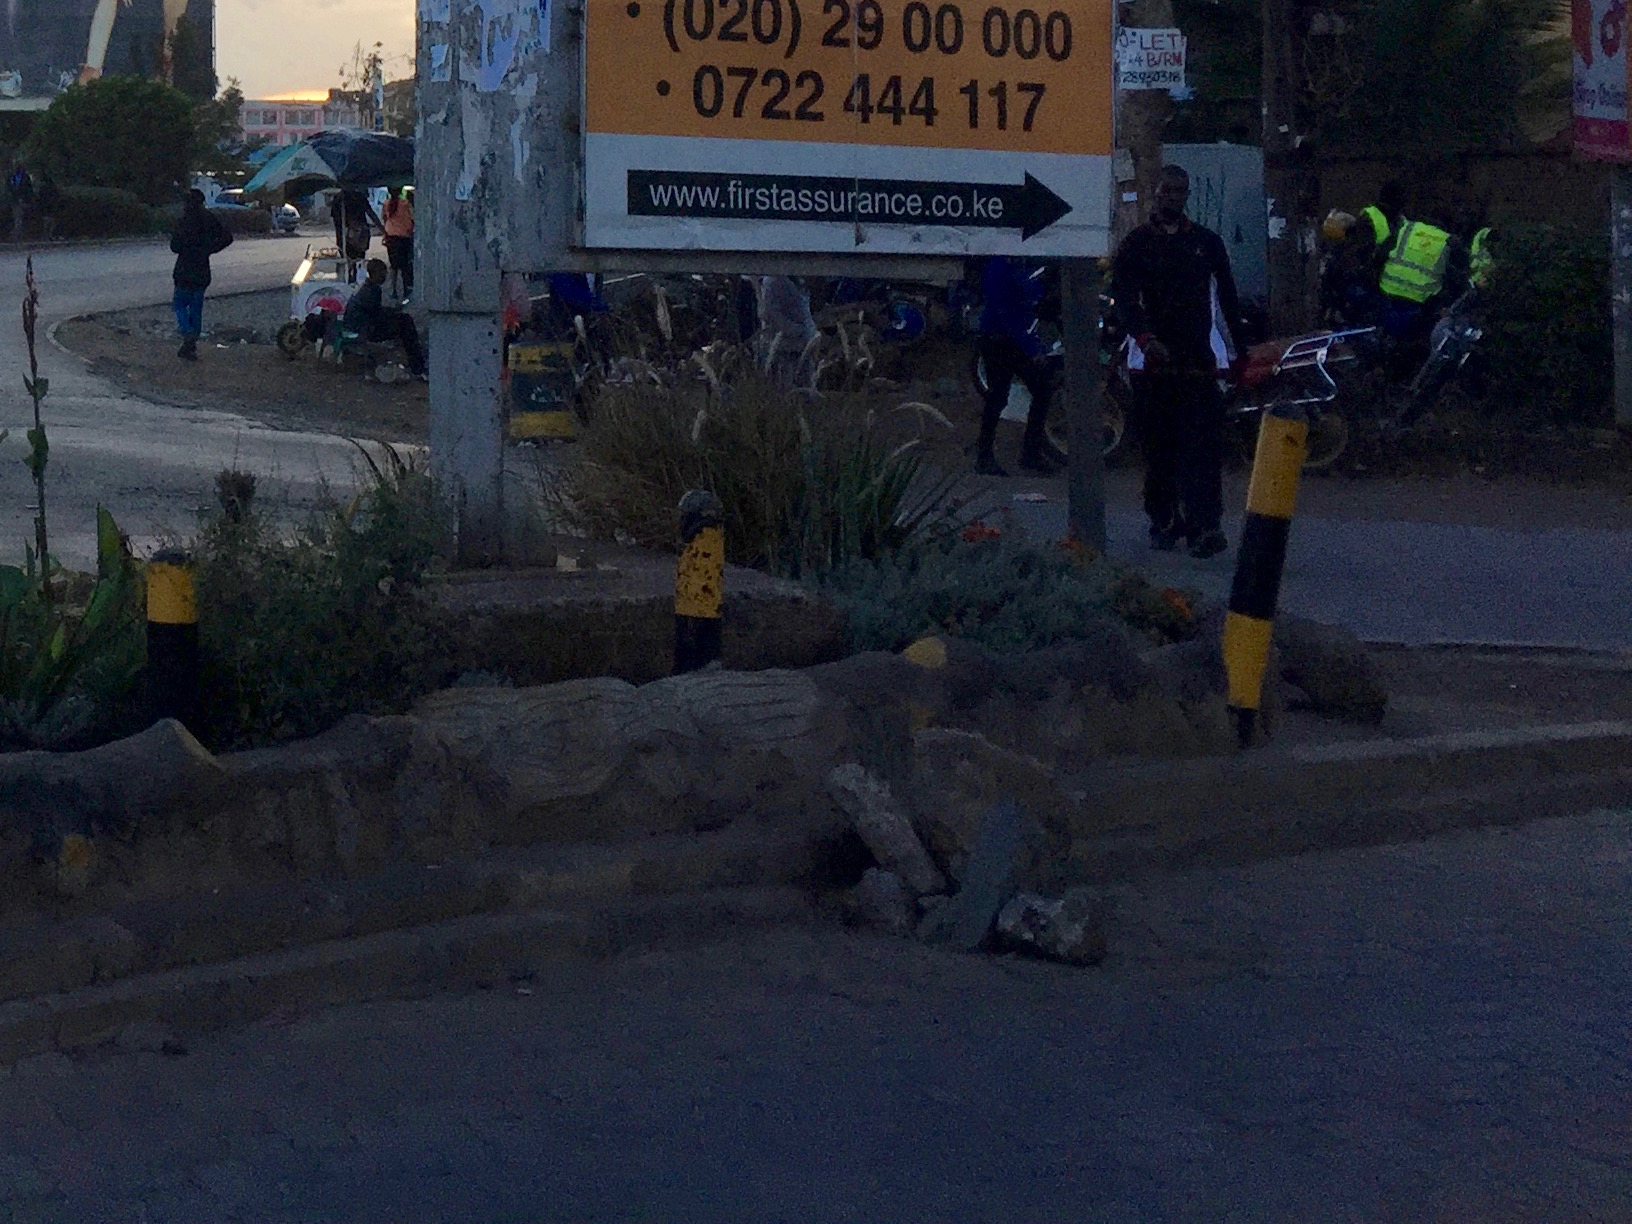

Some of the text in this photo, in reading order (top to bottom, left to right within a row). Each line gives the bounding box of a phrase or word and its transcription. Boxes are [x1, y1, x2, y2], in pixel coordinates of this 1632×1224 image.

[903, 1, 965, 56] 00
[982, 6, 1072, 62] 000
[692, 65, 1047, 133] 0722 444 117
[649, 178, 1005, 221] www.firstassurance.co.ke
